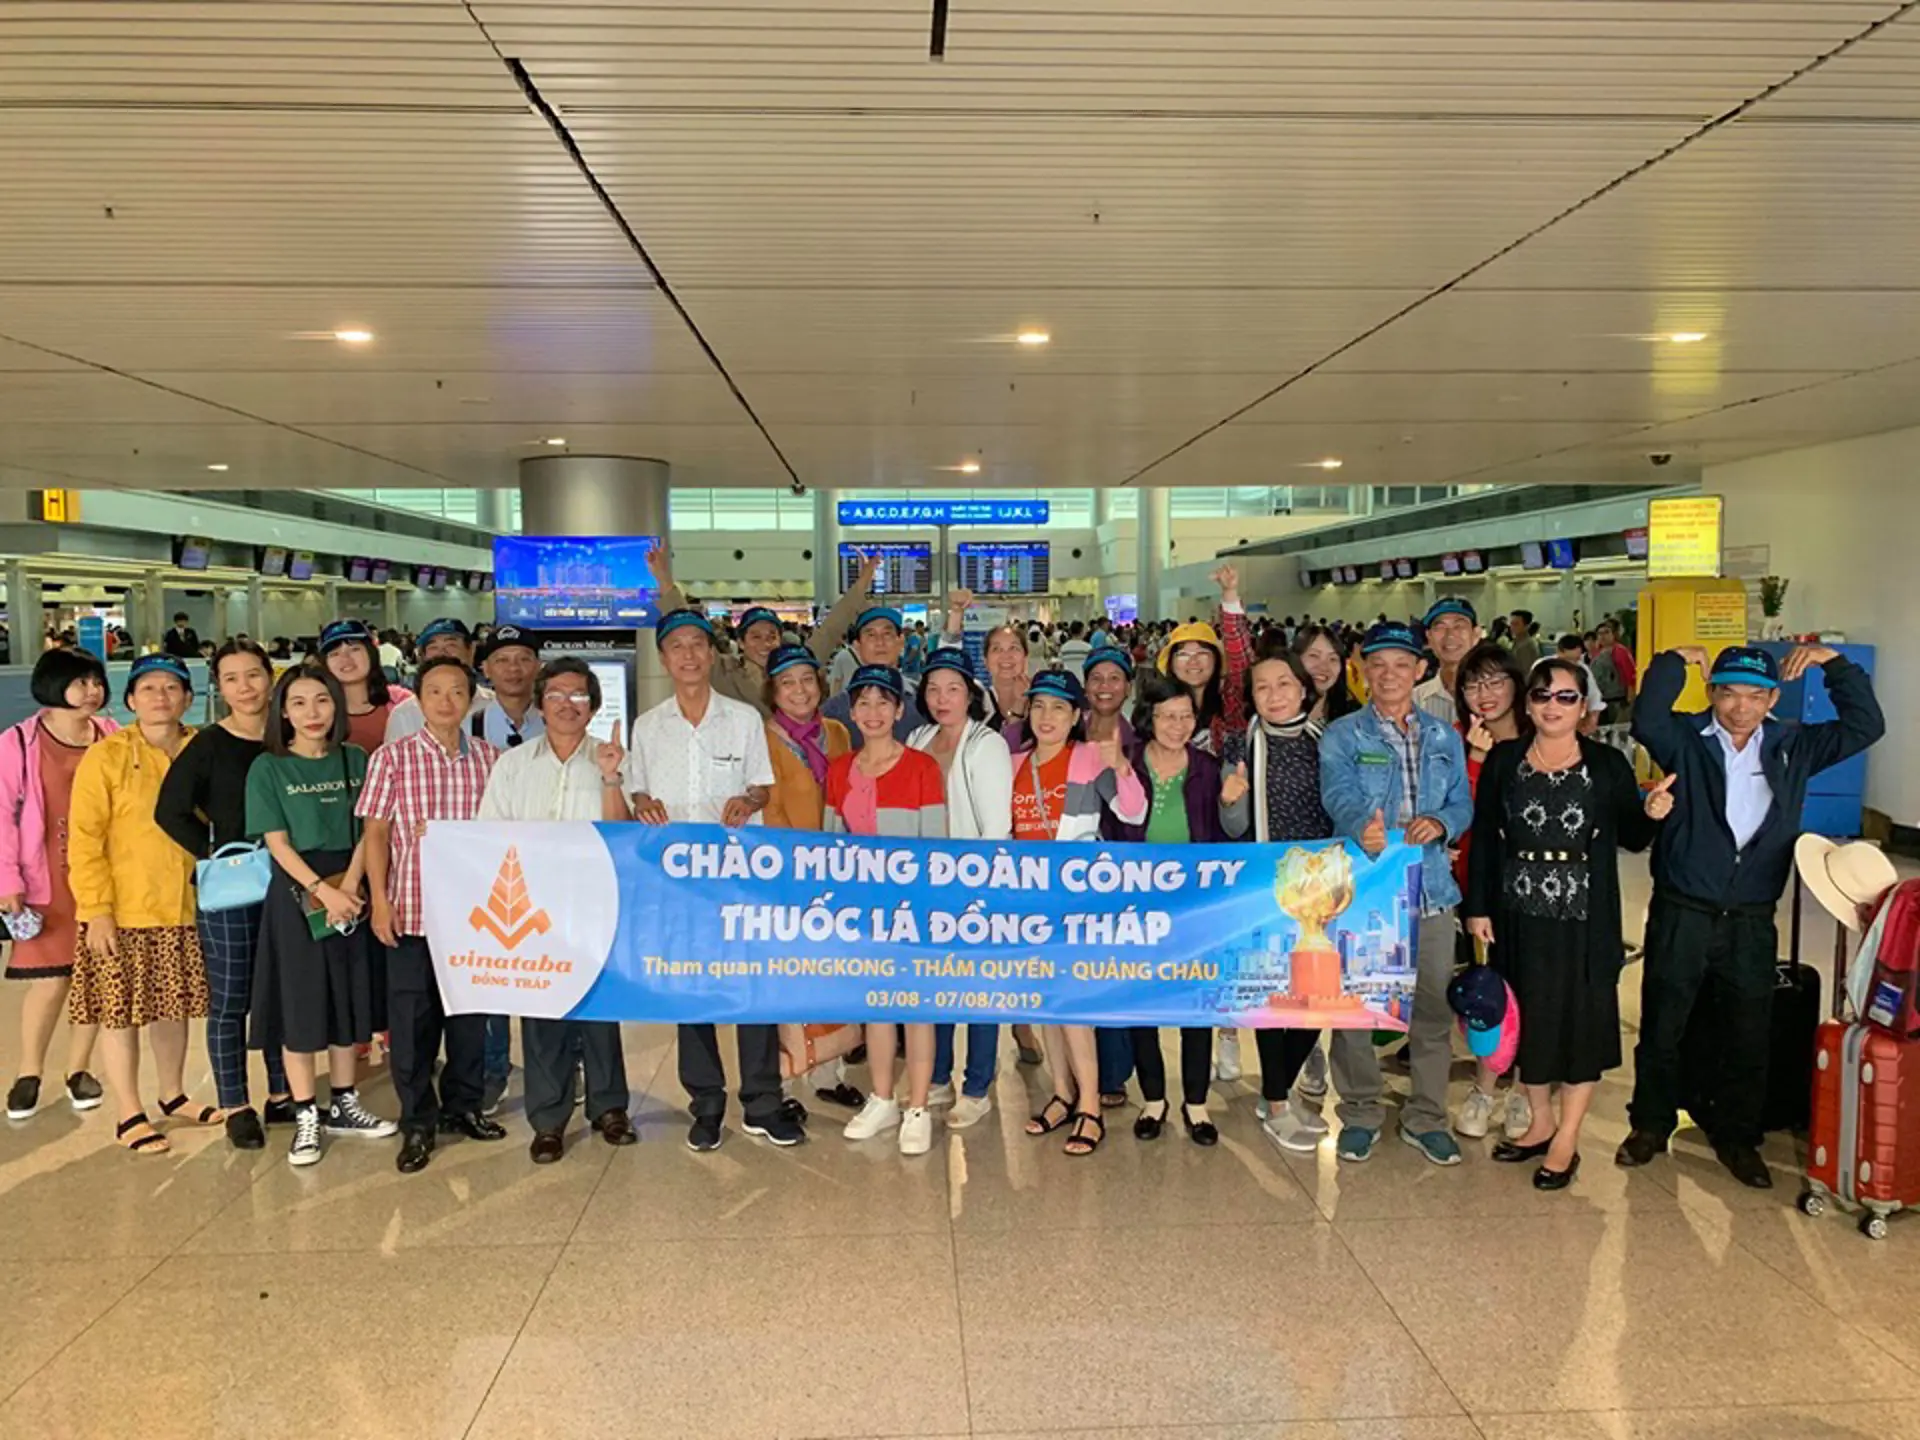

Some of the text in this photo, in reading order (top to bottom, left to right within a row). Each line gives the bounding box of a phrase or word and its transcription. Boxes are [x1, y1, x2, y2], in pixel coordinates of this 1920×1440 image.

[662, 836, 1246, 892] CHÀO MỪNG ĐOÀN CÔNG TY
[720, 892, 1171, 945] THUỐC LÁ ĐỒNG THÁP
[448, 949, 573, 973] vinataba
[643, 956, 702, 977] Tham
[708, 960, 762, 979] quan
[767, 957, 895, 977] HONGKONG
[1072, 957, 1152, 981] QUẢNG
[1156, 959, 1219, 981] CHÂU
[865, 991, 920, 1008] 03/08
[935, 992, 1042, 1009] 07/08/2019
